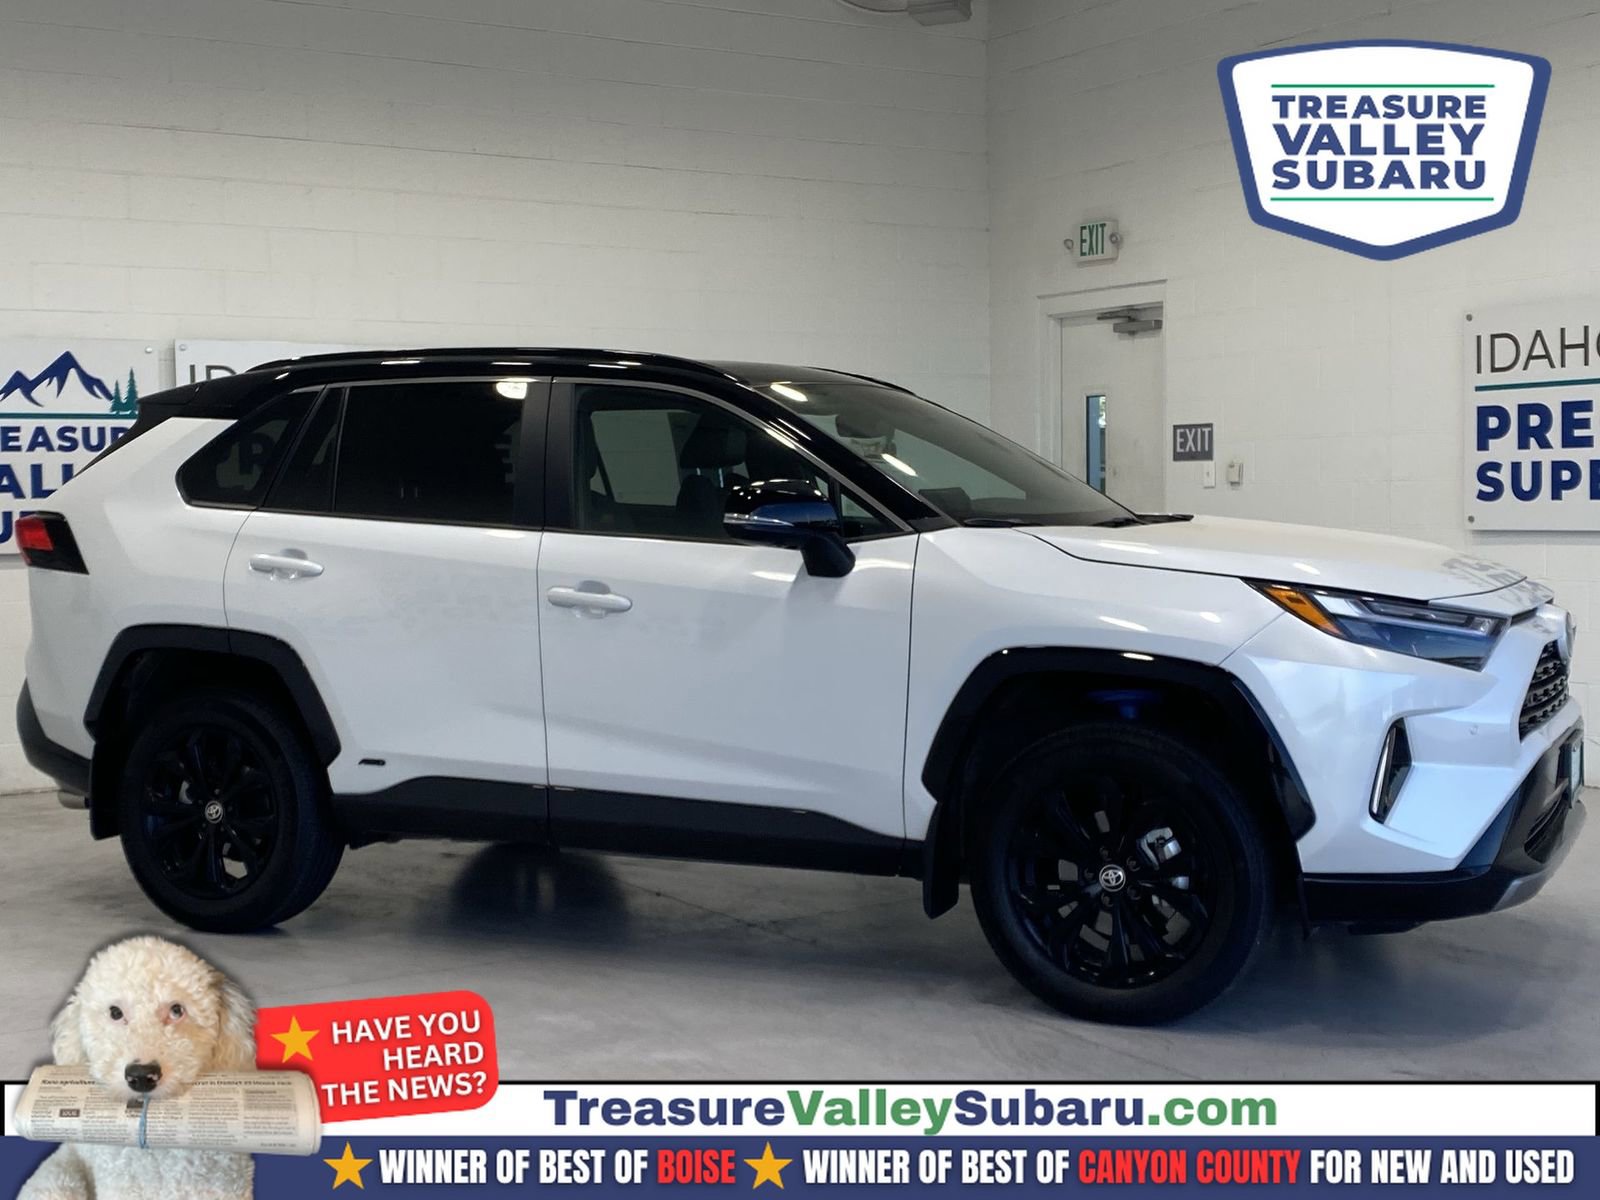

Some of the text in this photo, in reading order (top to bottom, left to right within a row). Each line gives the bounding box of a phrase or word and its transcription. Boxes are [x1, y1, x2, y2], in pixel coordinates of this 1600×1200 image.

[1080, 223, 1106, 256] EXIT
[1476, 325, 1600, 374] IDAH
[1176, 427, 1212, 452] EXIT
